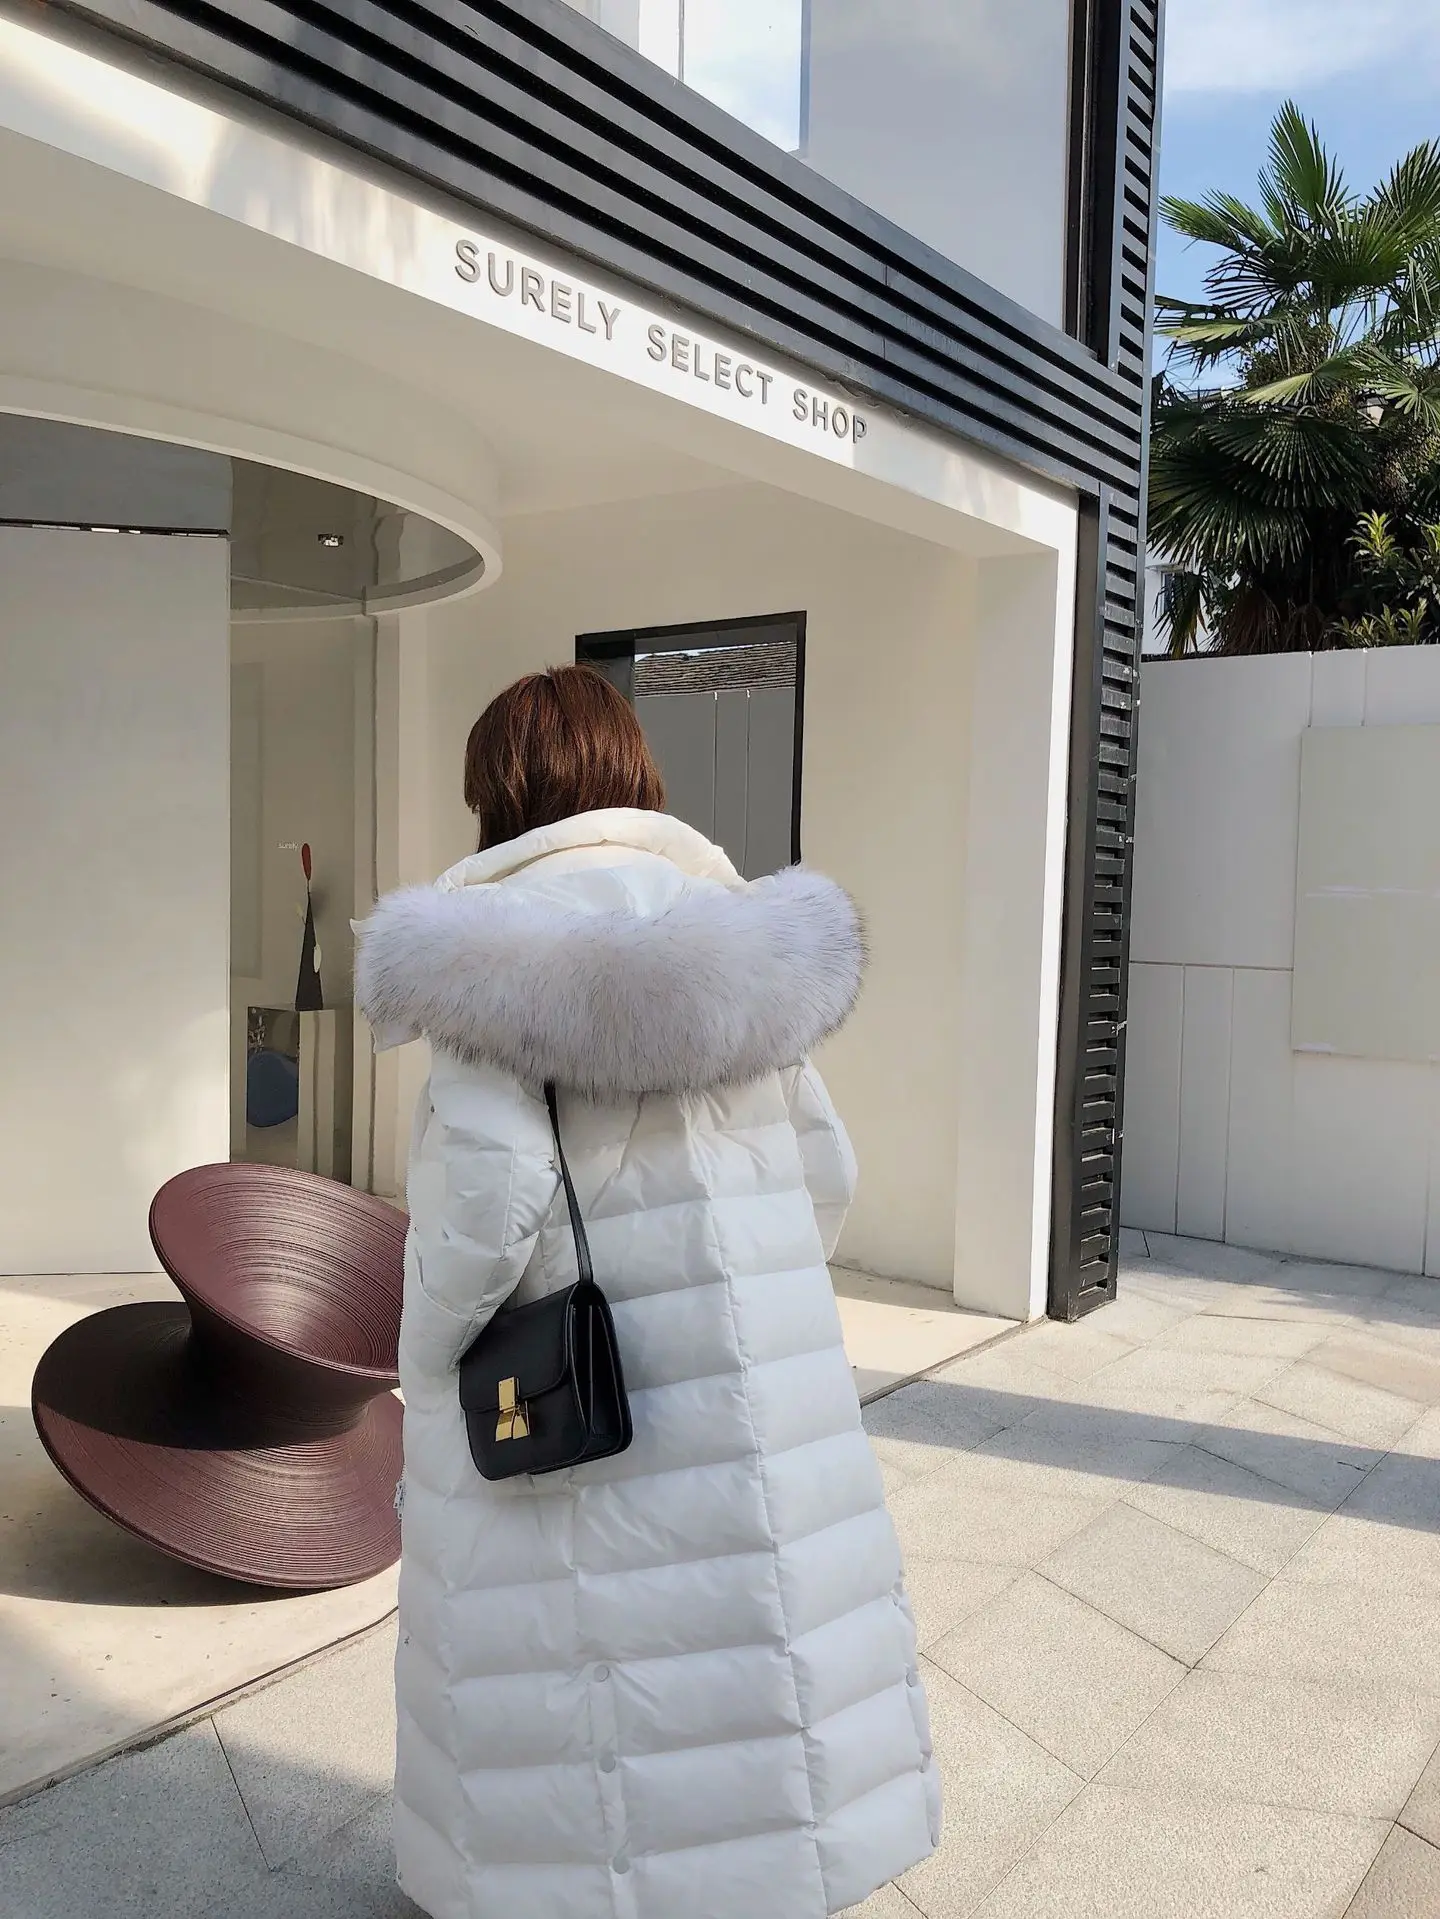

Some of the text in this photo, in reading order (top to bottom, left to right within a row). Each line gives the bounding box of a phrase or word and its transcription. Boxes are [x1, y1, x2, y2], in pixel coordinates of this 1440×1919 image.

[454, 239, 868, 444] SURELY SELECT SHOP
